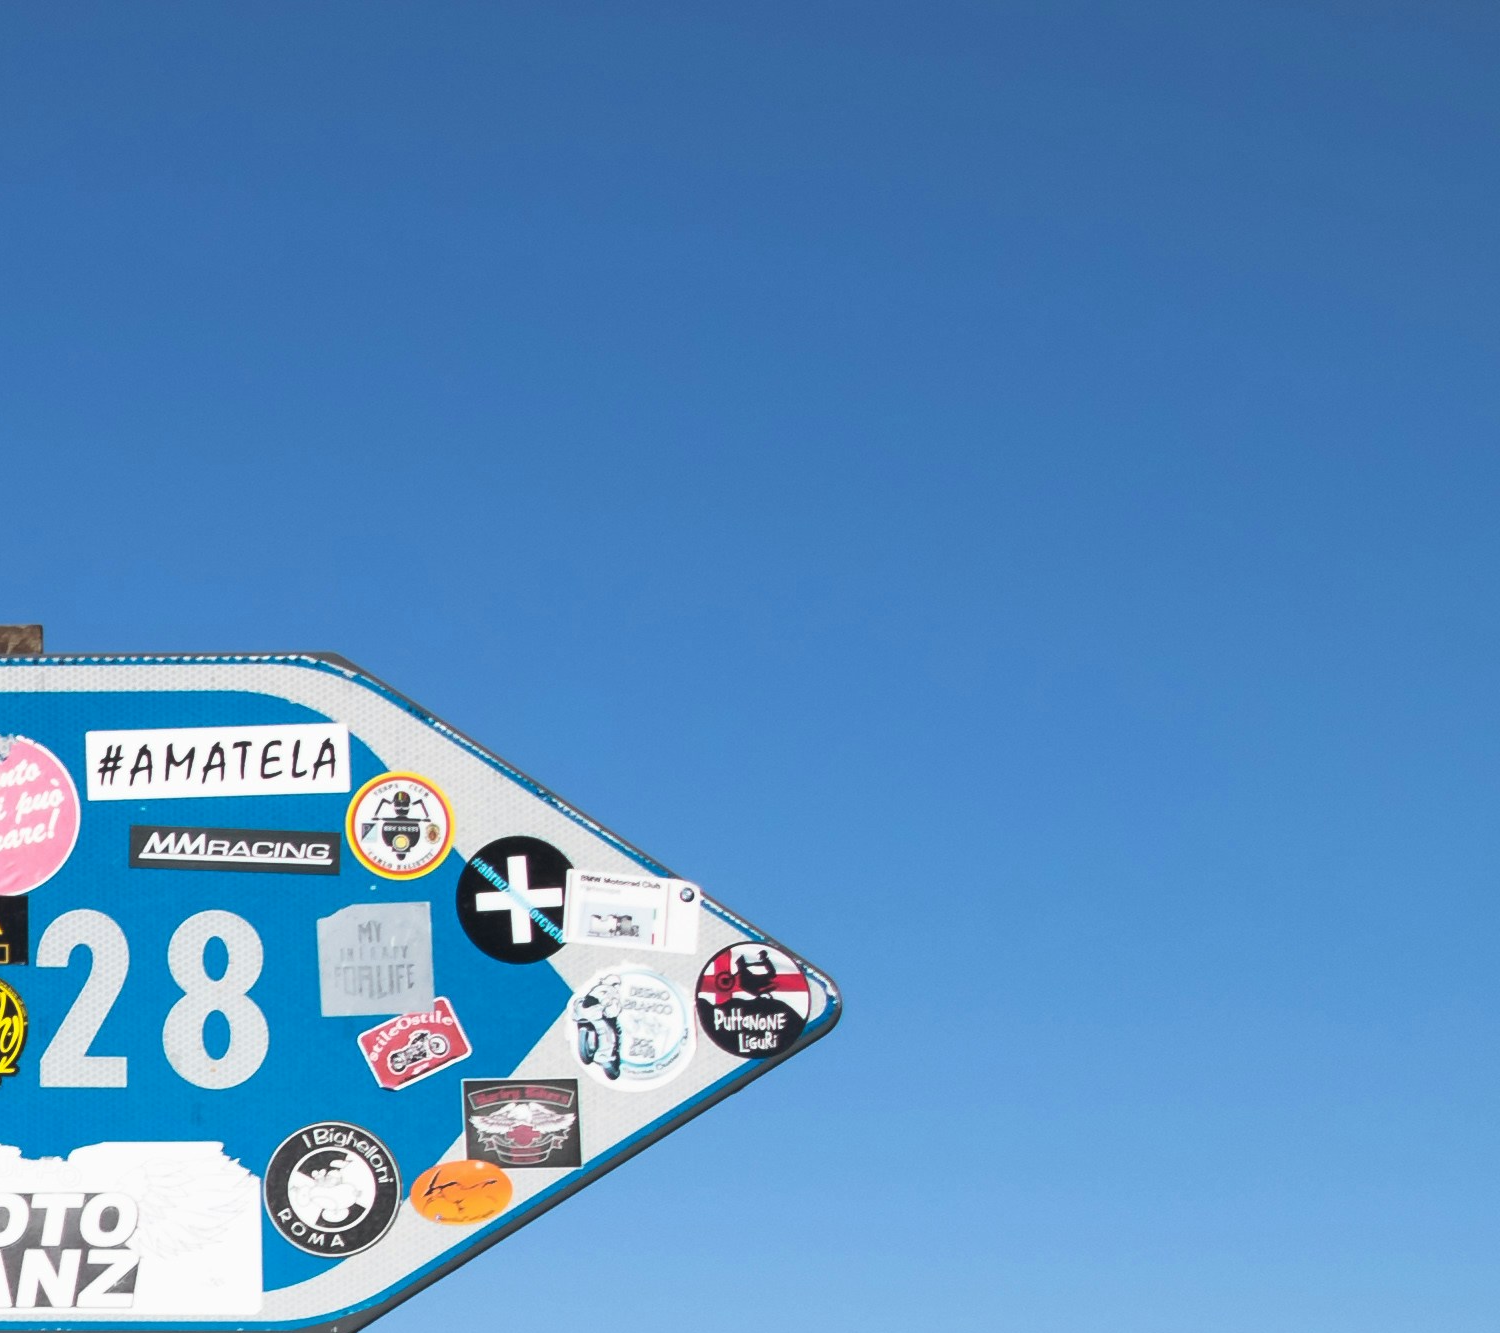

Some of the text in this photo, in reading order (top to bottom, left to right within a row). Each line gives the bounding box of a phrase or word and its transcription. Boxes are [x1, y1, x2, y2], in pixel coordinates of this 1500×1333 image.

[97, 737, 337, 787] #AMATELA
[15, 778, 65, 820] può
[358, 921, 383, 944] MY
[33, 908, 270, 1091] 28
[369, 1009, 454, 1062] stileOstile
[313, 1127, 395, 1185] Bighelloni
[277, 1210, 346, 1248] ROMA
